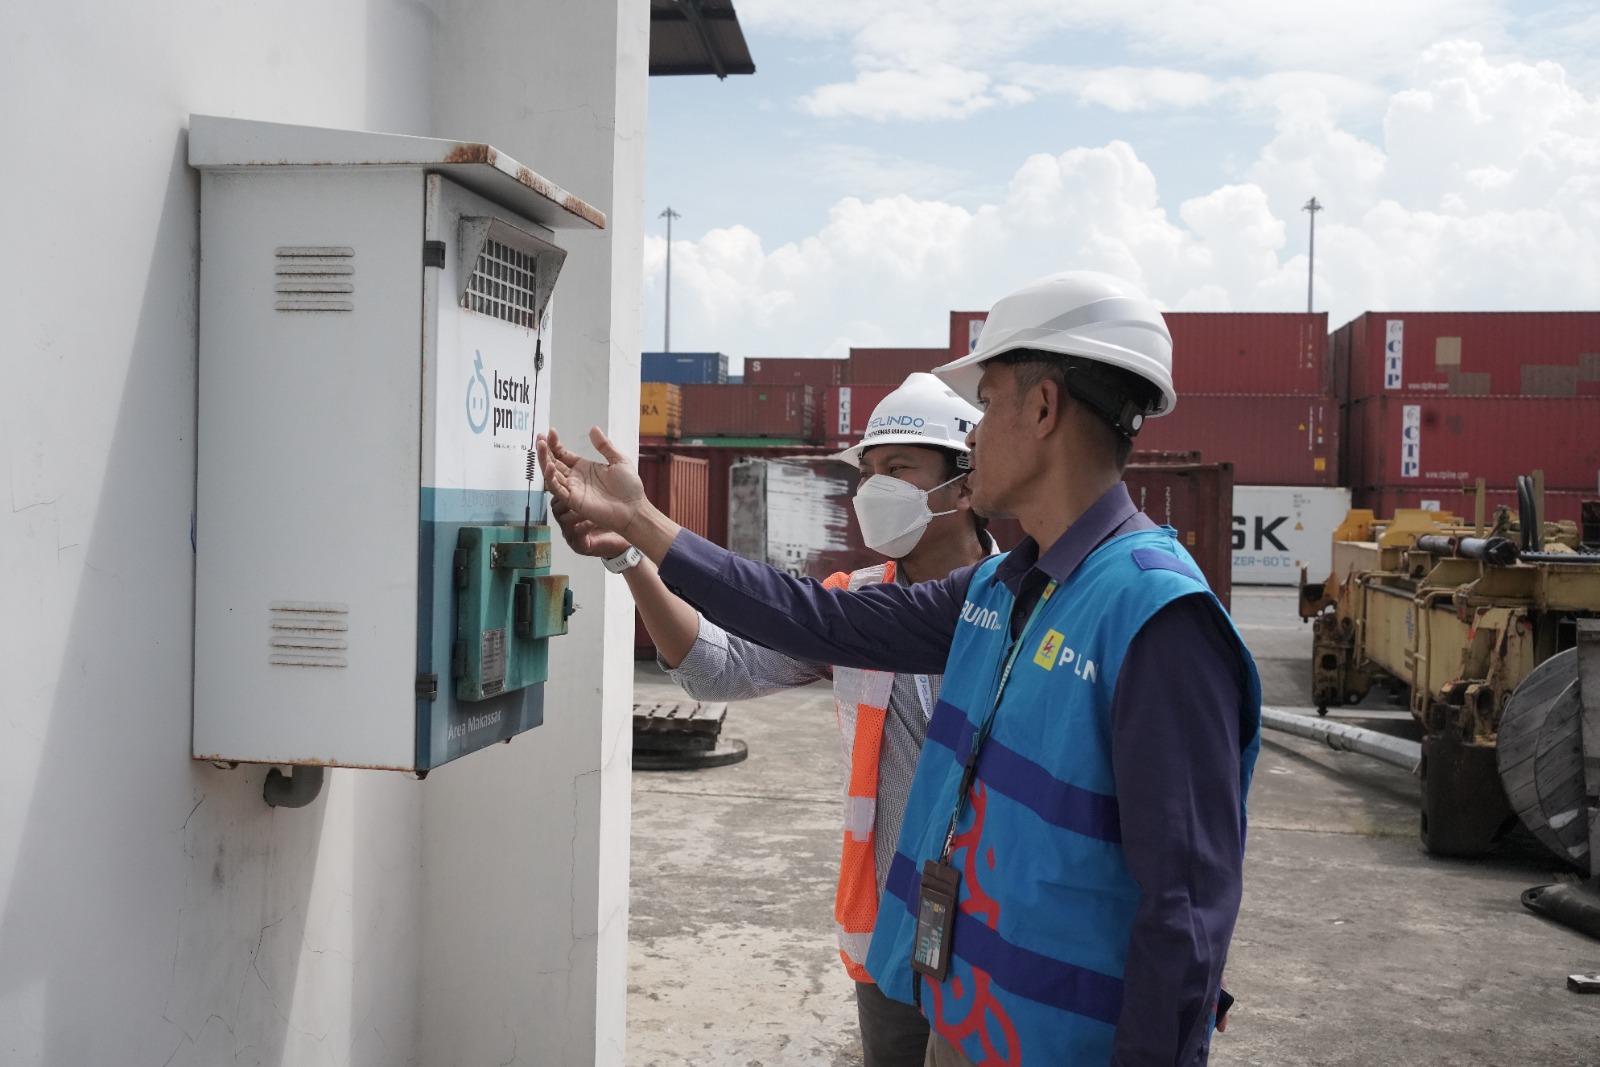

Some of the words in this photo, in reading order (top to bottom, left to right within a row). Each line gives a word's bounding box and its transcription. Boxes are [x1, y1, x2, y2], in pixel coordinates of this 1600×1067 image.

[1387, 340, 1401, 386] CTP
[494, 406, 530, 436] pintar
[1404, 426, 1418, 475] CTP
[1058, 646, 1099, 684] PLN
[448, 723, 466, 741] Area
[467, 710, 502, 733] Makassar
